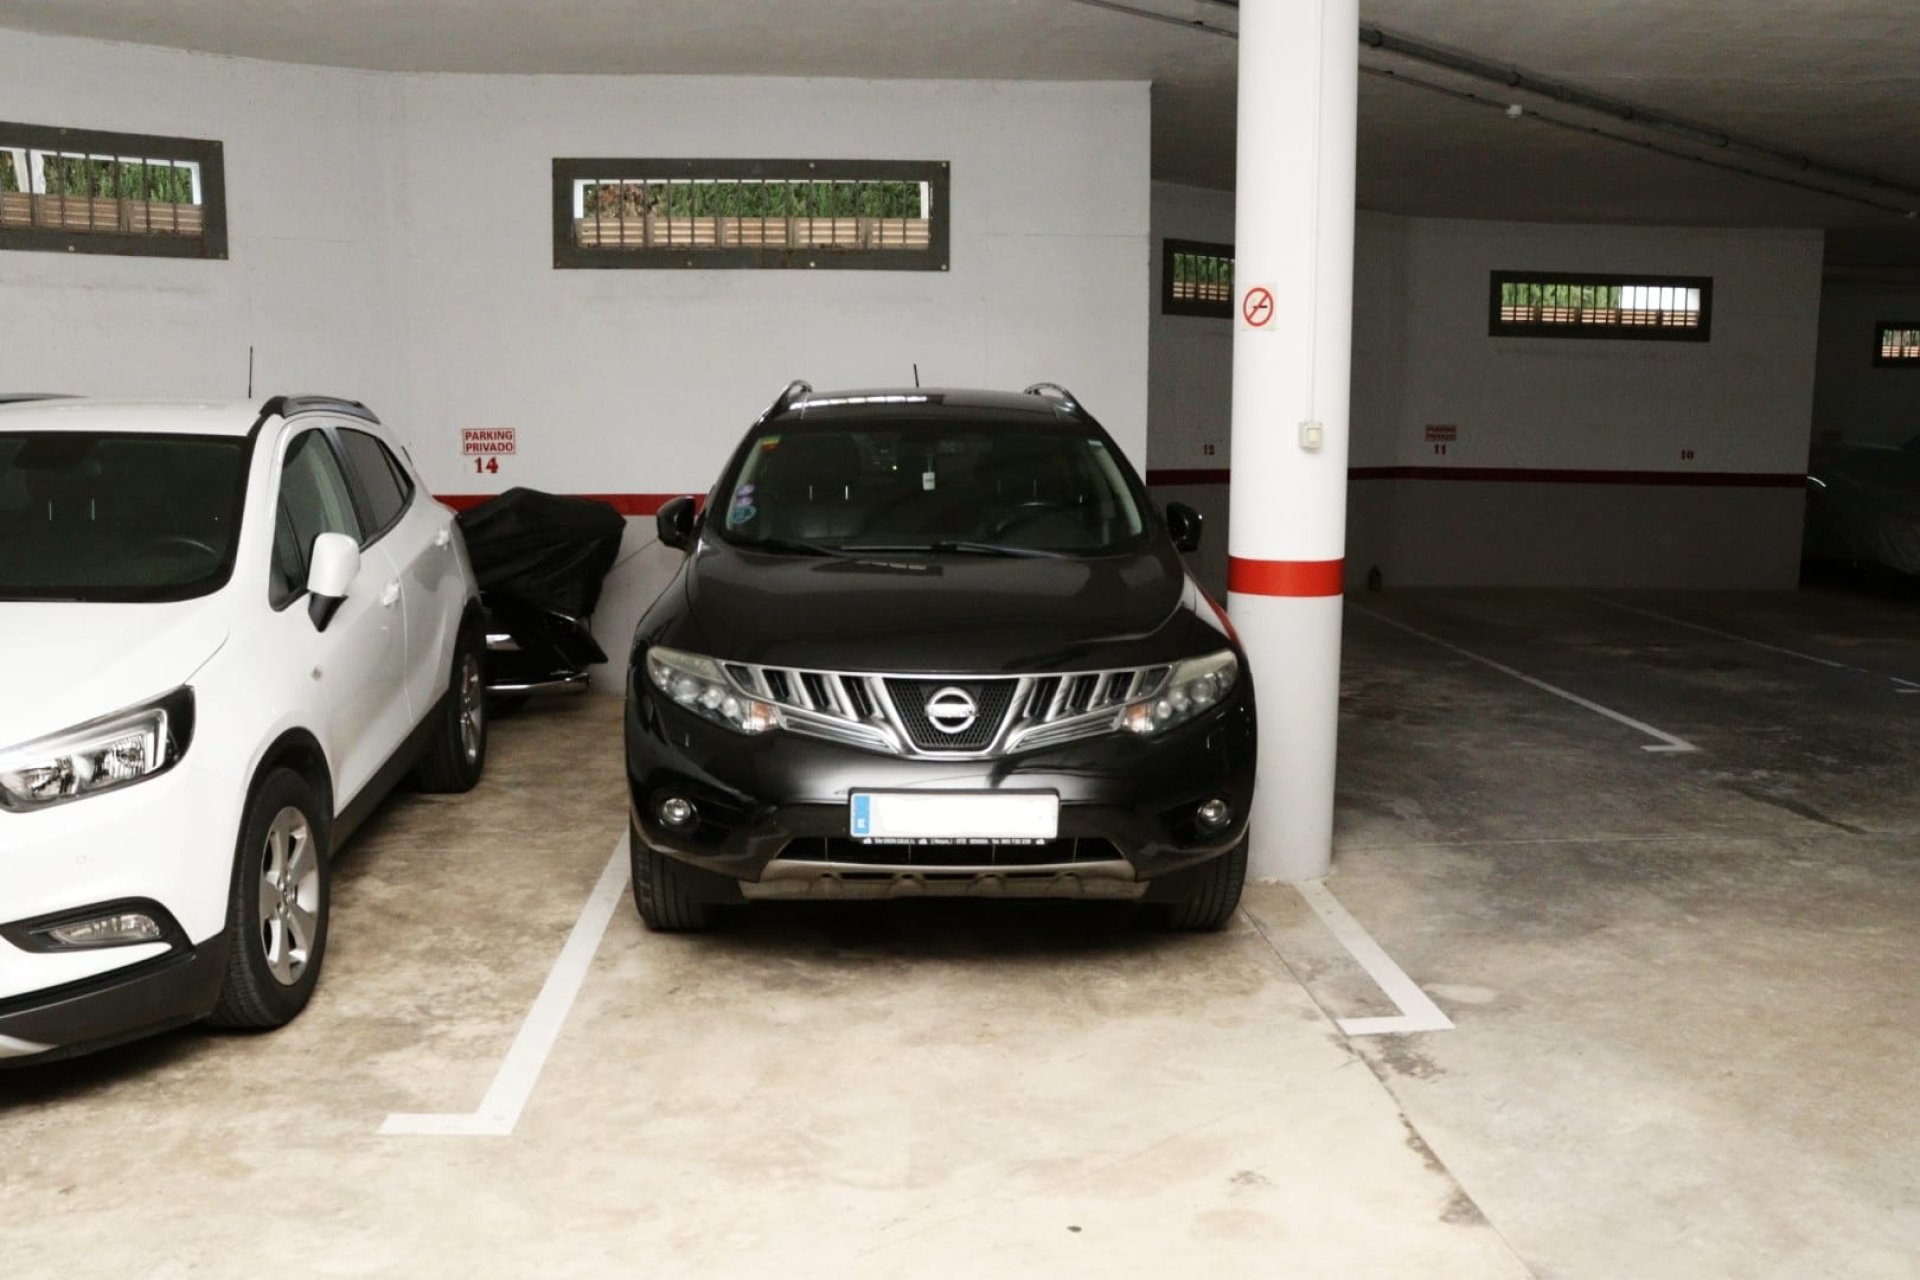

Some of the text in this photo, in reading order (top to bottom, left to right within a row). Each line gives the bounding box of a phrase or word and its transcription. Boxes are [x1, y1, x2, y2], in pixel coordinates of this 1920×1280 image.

[465, 430, 513, 441] PARKING
[466, 442, 513, 452] PRIVADO
[1434, 444, 1446, 455] 11
[1681, 449, 1695, 461] 10
[474, 457, 499, 474] 14
